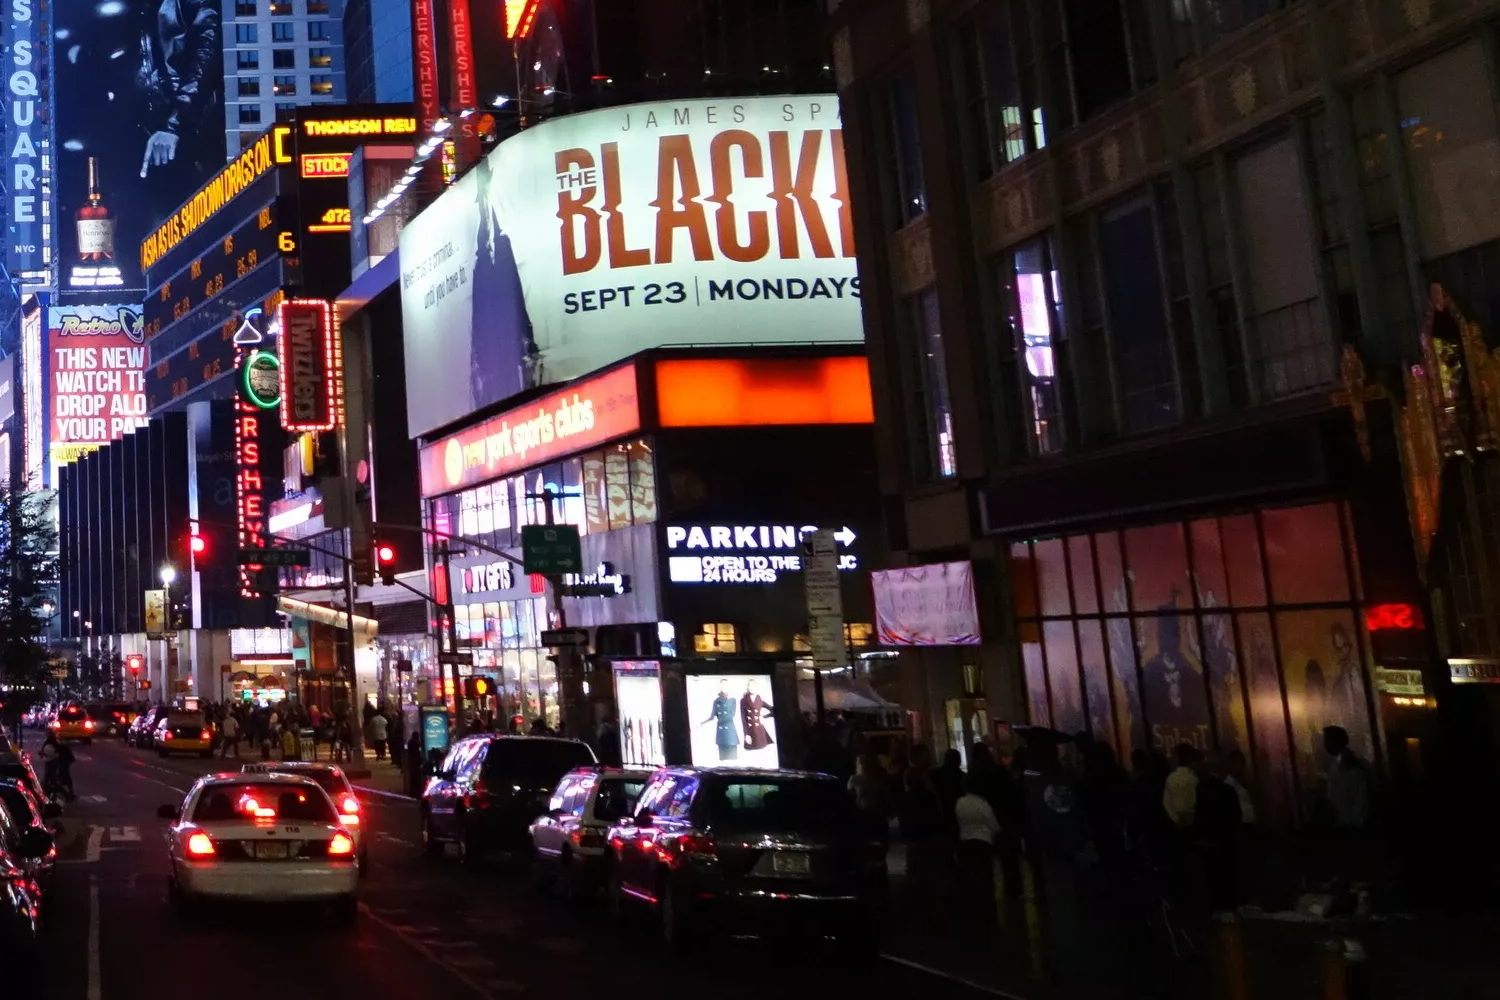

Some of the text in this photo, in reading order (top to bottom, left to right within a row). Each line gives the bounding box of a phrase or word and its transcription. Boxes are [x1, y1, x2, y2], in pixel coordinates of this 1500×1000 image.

[453, 8, 474, 138] HERSHES
[304, 119, 381, 135] THOMSON
[622, 104, 746, 132] JAMES
[9, 40, 38, 223] SQUARE
[556, 168, 596, 188] THE
[180, 172, 225, 237] SHUTDOWN
[224, 147, 255, 202] DRAGS
[14, 244, 36, 254] NYC
[278, 231, 295, 251] 6
[564, 277, 862, 314] SEPT 23 MONDAYS
[60, 314, 121, 336] Retro
[55, 347, 145, 369] THIS NEW
[55, 371, 121, 392] WATCH
[56, 393, 146, 416] DROP ALO
[56, 417, 106, 442] YOUR
[463, 393, 595, 471] new york sports clubs
[702, 555, 800, 570] OPEN TO THE
[486, 561, 511, 592] GIFTS
[703, 569, 777, 583] 24 HOURS
